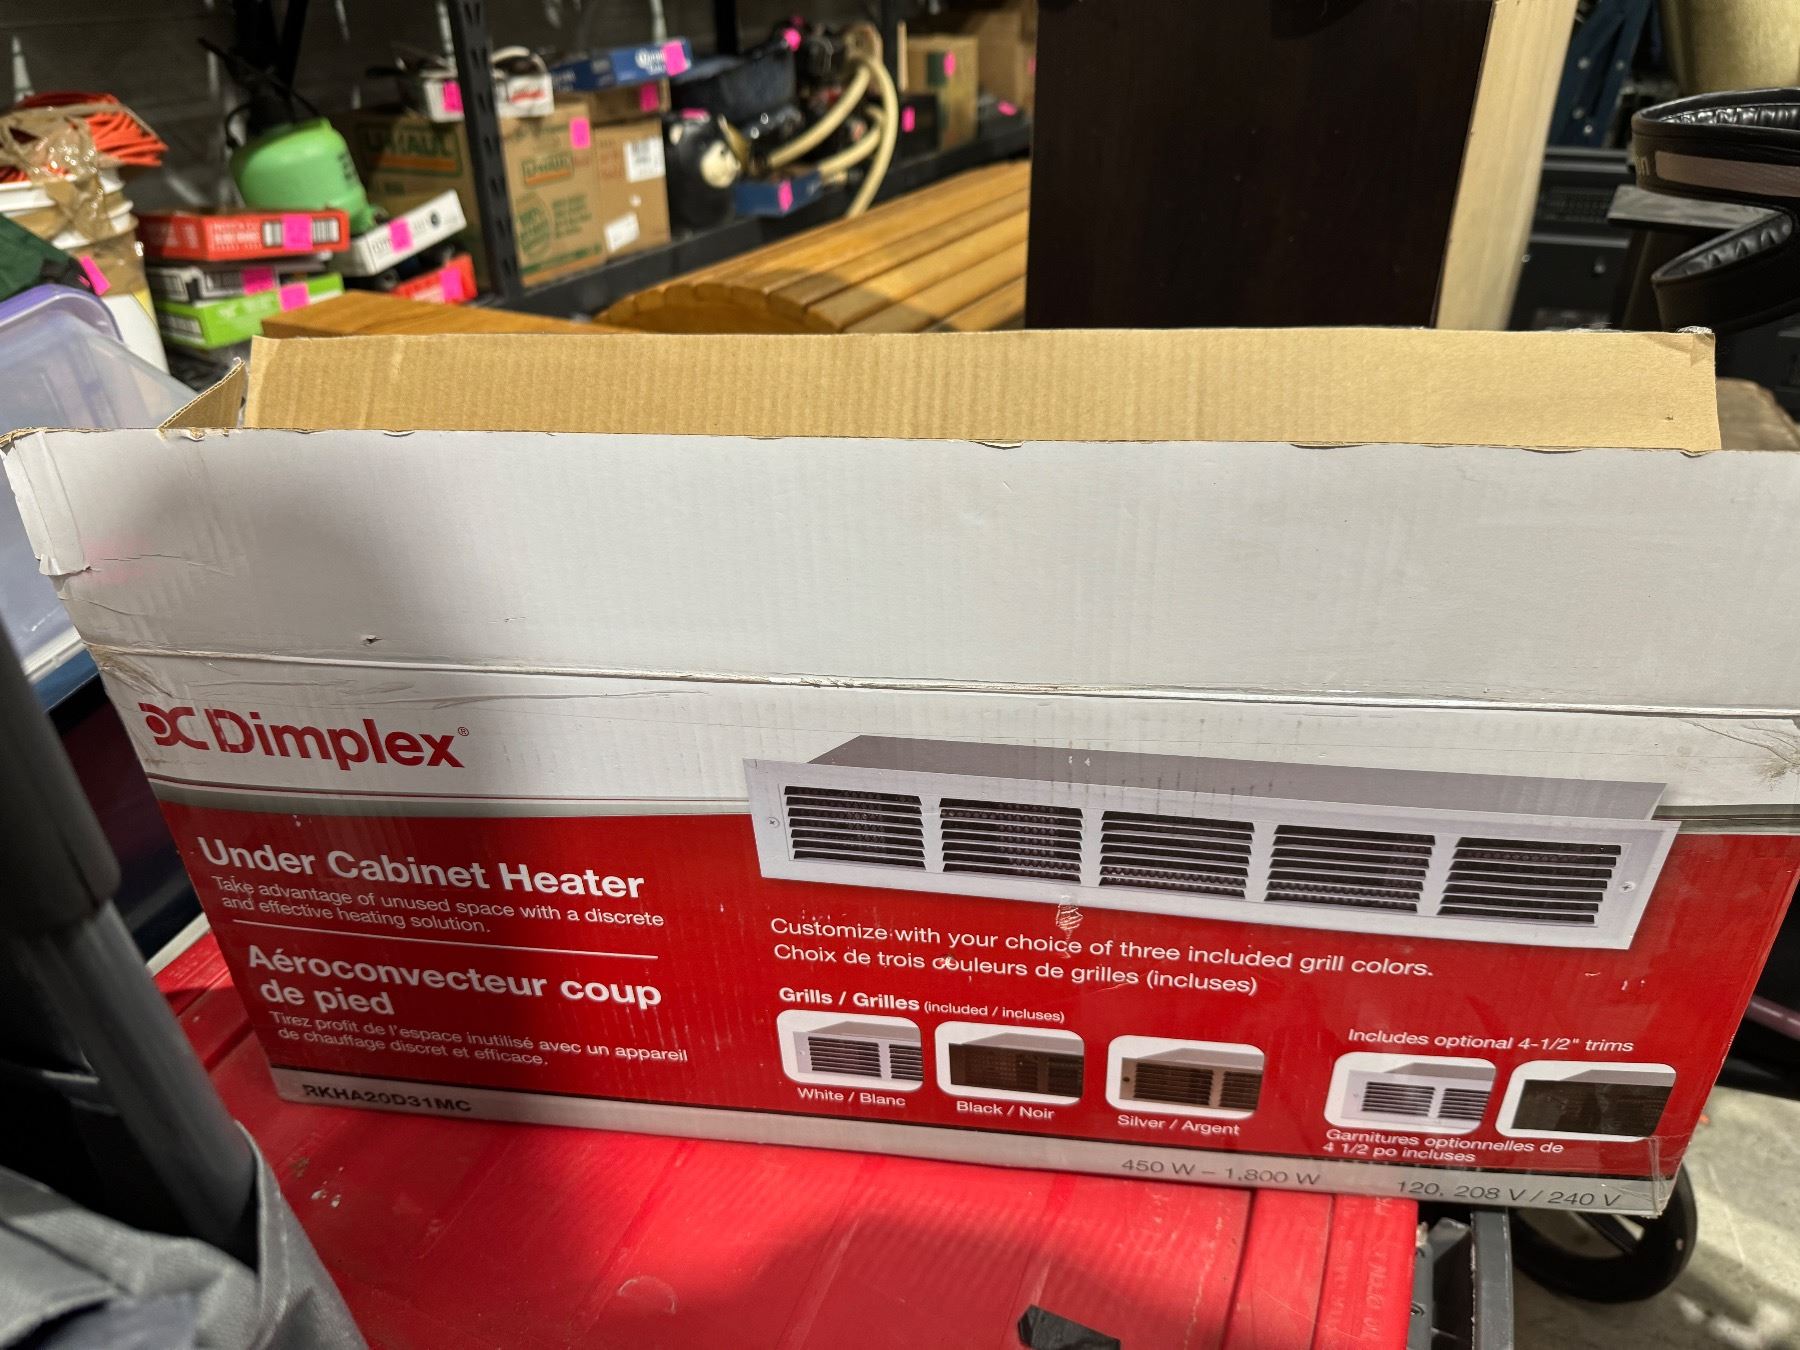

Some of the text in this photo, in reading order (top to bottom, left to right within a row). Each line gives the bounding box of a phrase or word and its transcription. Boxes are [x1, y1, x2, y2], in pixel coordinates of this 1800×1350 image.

[197, 837, 645, 898] Under Cabinet Heater
[212, 875, 664, 926] Take advantage of unused space with a discrete
[223, 896, 491, 933] and effective heating solution.
[770, 917, 1434, 976] Customize with your choice of three included grill colors.
[249, 944, 662, 1010] Aéroconvecteur coup
[774, 944, 1258, 996] Choix de trois couleurs de grilles (incluses)
[260, 979, 395, 1015] de pied
[779, 986, 1065, 1024] Grills / Grilles (included / incluses)
[268, 1011, 312, 1027] Tirez
[315, 1018, 360, 1033] profit
[363, 1022, 385, 1035] de
[466, 1031, 534, 1049] inutilisé
[539, 1040, 582, 1054] avec
[586, 1043, 610, 1056] un
[615, 1045, 688, 1063] appareil
[278, 1027, 548, 1066] de chauffage discret et efficace.
[1347, 1028, 1634, 1053] Includes optional 4-1/2" trims
[302, 1083, 473, 1112] RKHA20D31MC
[797, 1087, 906, 1107] White / Blanc
[956, 1101, 1056, 1120] Black / Noir
[1117, 1114, 1241, 1137] Silver / Argent
[1326, 1128, 1564, 1154] Garnitures optionnelles de
[1322, 1141, 1476, 1163] 4 1/2 po incluses
[1121, 1158, 1165, 1173] 450
[1172, 1161, 1198, 1176] W
[1295, 1170, 1322, 1186] W
[1396, 1180, 1622, 1208] 120, 208 V / 240 V
